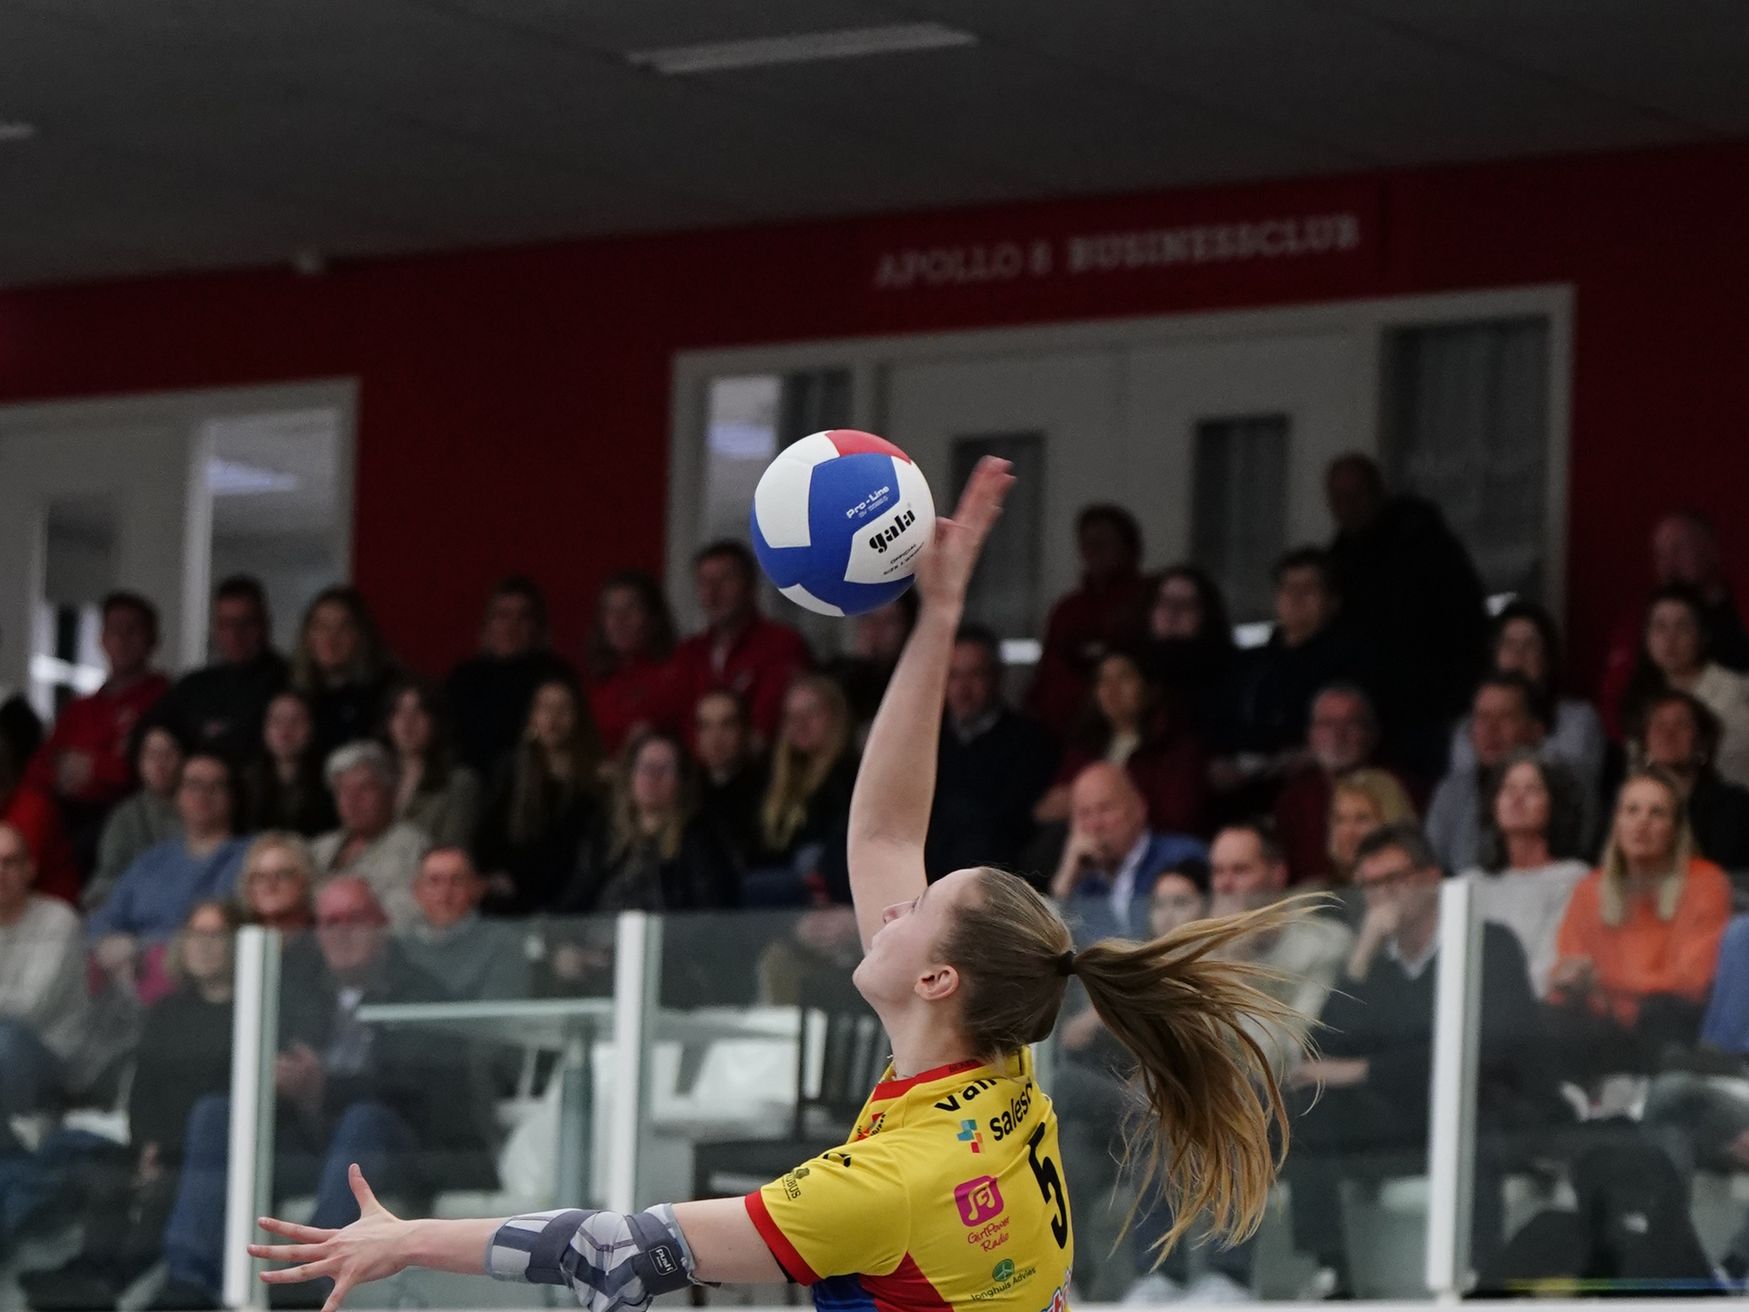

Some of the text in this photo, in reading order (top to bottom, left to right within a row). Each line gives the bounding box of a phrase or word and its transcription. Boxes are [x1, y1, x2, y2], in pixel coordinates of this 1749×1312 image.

[874, 242, 1022, 289] APOLLO
[1067, 213, 1359, 276] BUSINESSCLUB
[869, 510, 916, 553] gala
[1028, 1122, 1067, 1250] 5
